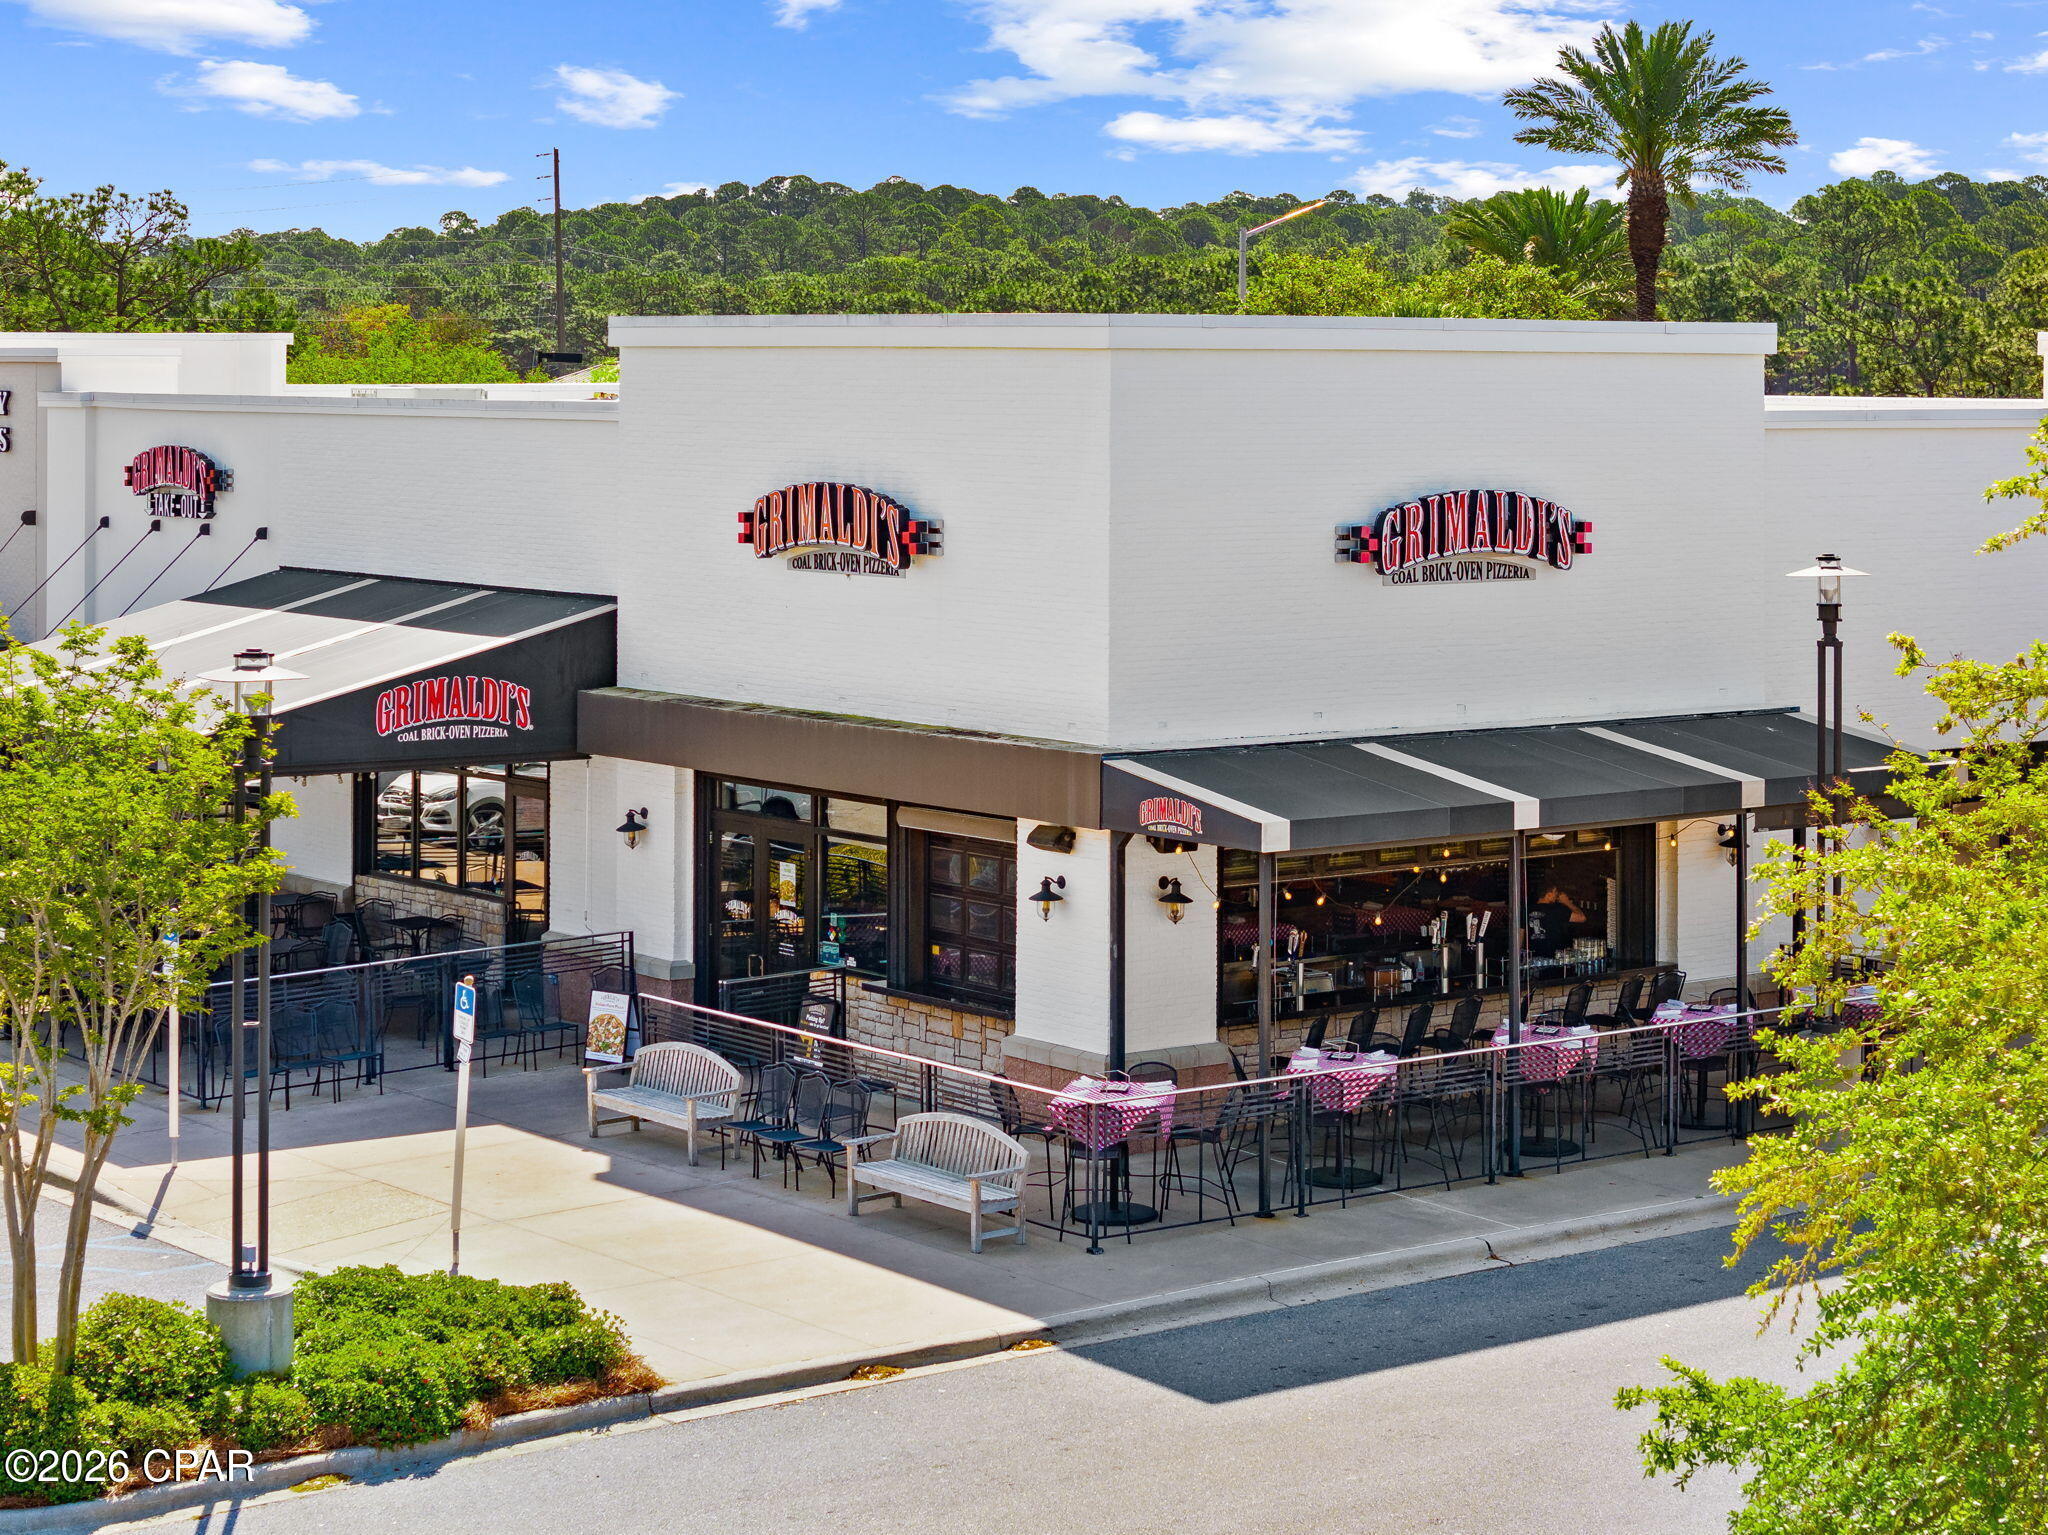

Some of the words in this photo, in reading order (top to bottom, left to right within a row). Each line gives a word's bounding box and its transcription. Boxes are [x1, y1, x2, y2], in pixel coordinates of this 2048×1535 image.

[133, 446, 207, 501] GRIMALDI'S
[154, 493, 198, 518] TAKE-OUT
[754, 483, 899, 569] GRIMALDI'S
[1382, 490, 1572, 575] GRIMALDI'S
[792, 557, 811, 569] COAL
[814, 552, 861, 574] BRICK-OVEN
[1392, 572, 1419, 585] COAL
[1422, 561, 1483, 582] BRICK-OVEN
[1486, 563, 1529, 580] PIZZERIA
[376, 676, 531, 737] GRIMALDI'S
[398, 731, 419, 742] COAL
[421, 725, 471, 741] BRICK-OVEN
[473, 727, 509, 738] PIZZERIA
[1140, 797, 1202, 834] GRIMALDI'S
